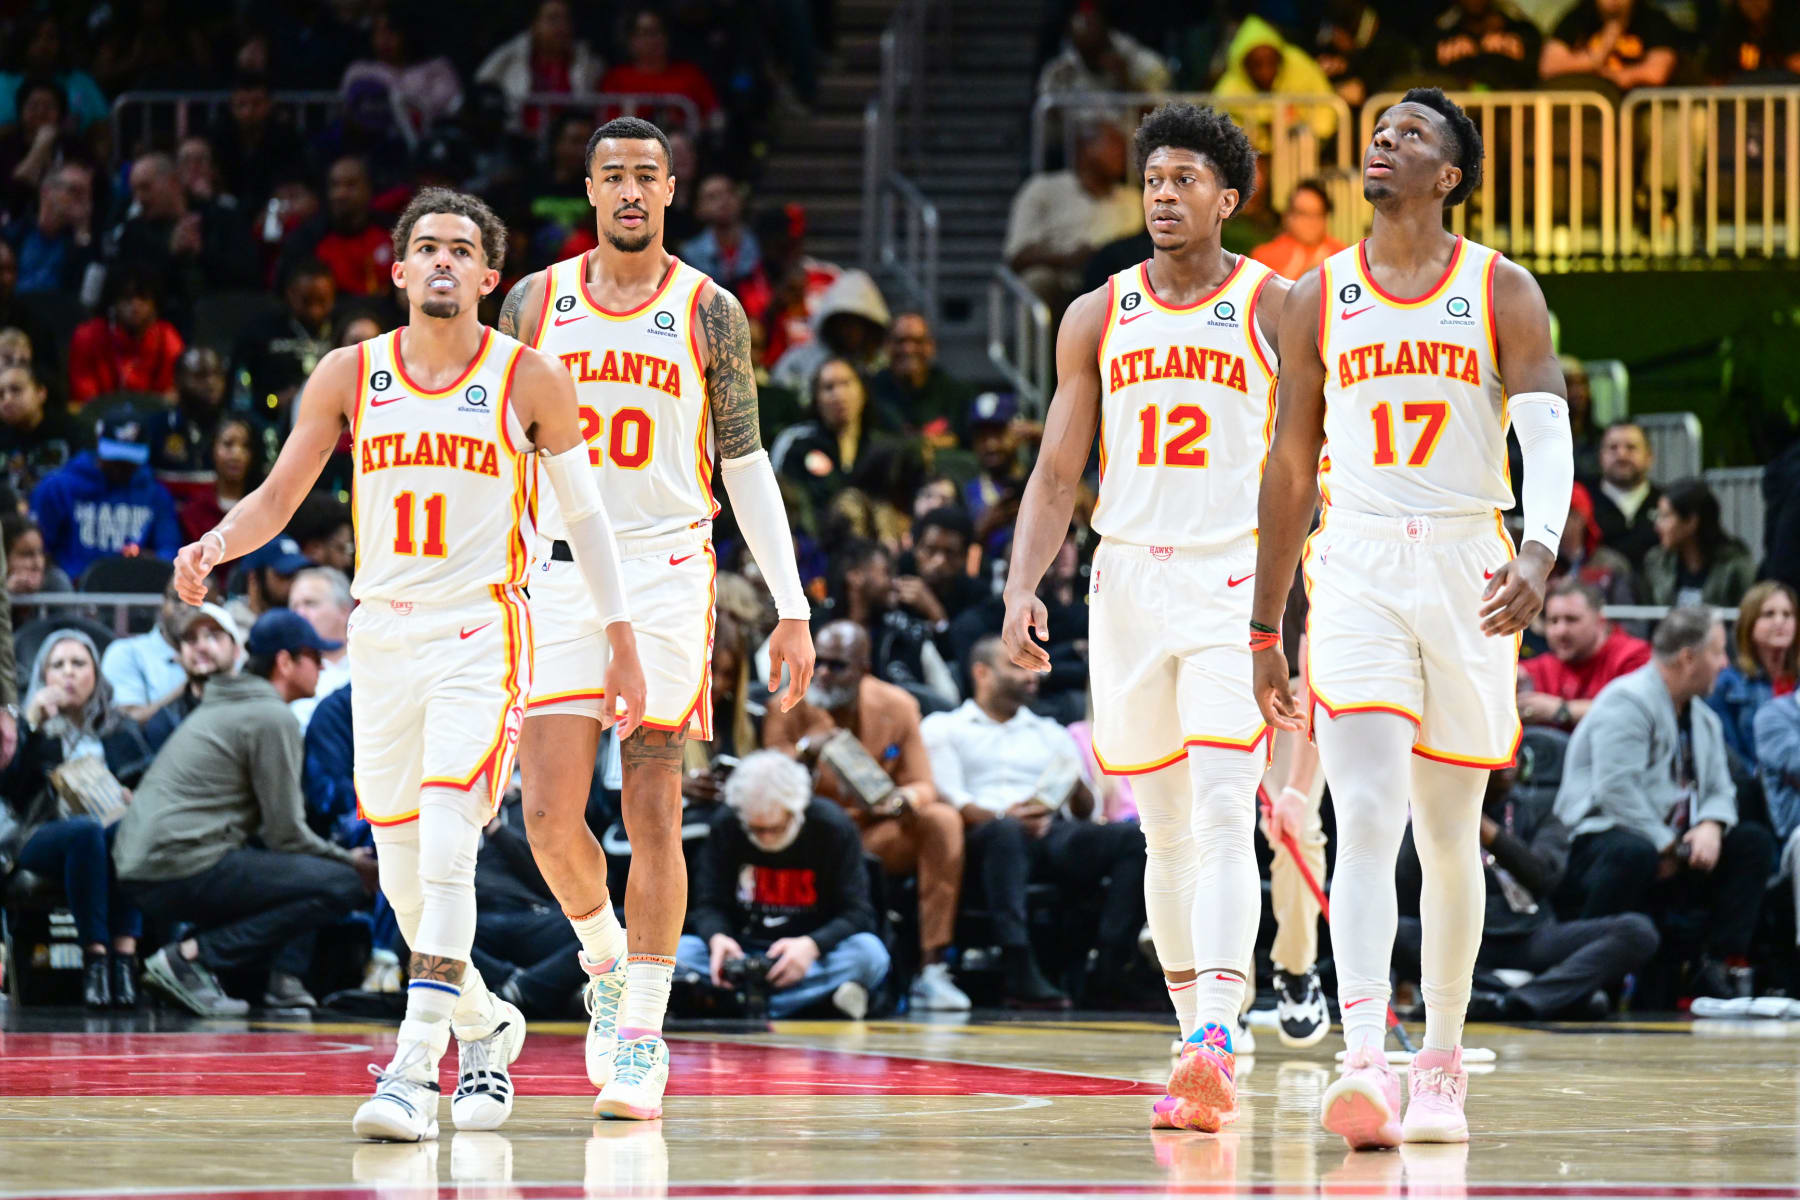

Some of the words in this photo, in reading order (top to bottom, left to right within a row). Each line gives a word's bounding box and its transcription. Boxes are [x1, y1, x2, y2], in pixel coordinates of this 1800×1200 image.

[1207, 320, 1239, 328] sharecare
[558, 350, 681, 400] TLANTA
[1110, 345, 1248, 395] ATLANTA
[1338, 340, 1481, 389] ATLANTA
[362, 431, 500, 478] ATLANTA
[577, 405, 656, 471] 20
[1137, 403, 1211, 469] 12
[1370, 400, 1451, 468] 17
[393, 490, 448, 559] 11
